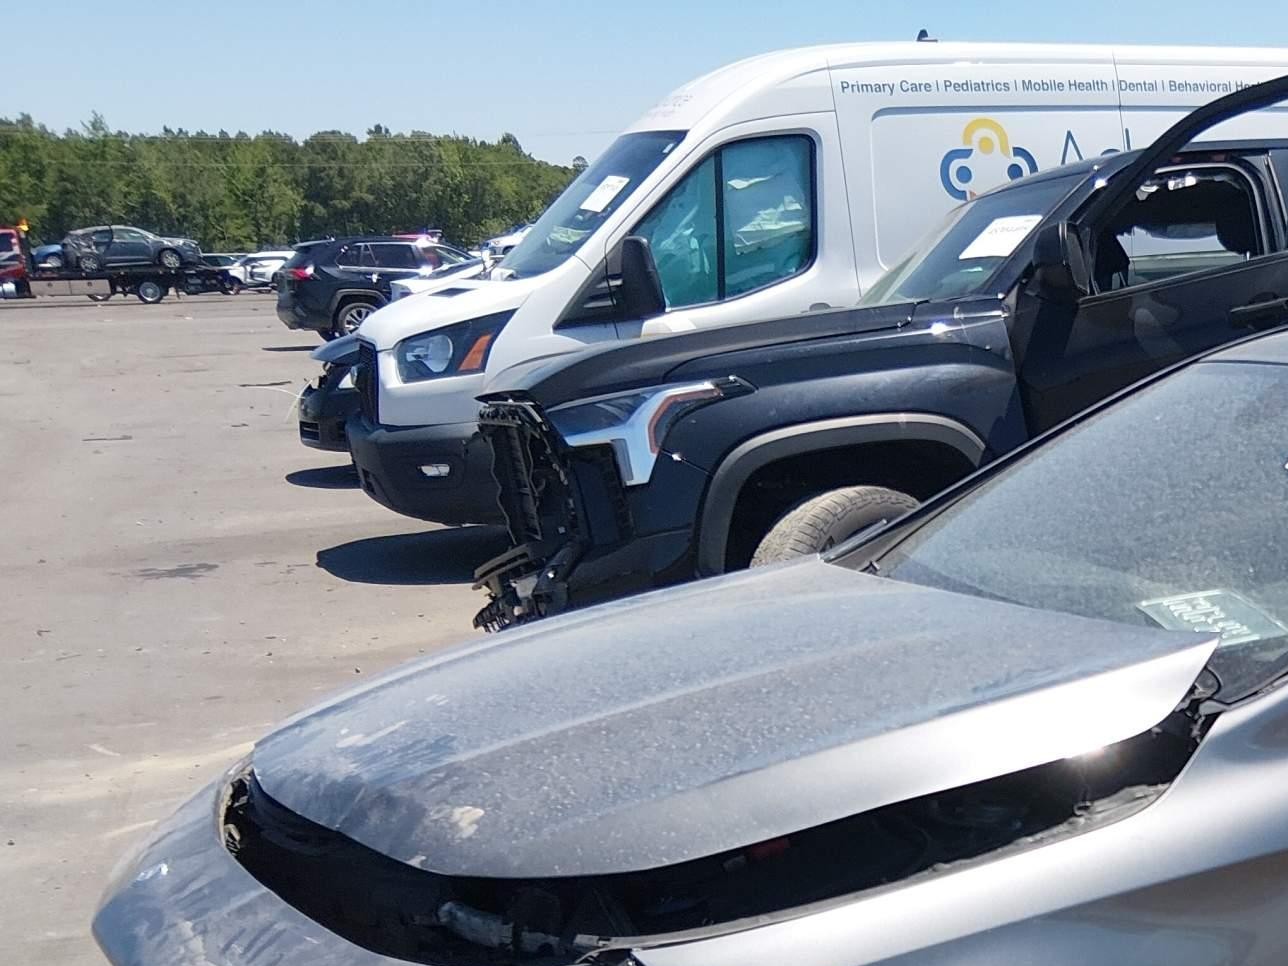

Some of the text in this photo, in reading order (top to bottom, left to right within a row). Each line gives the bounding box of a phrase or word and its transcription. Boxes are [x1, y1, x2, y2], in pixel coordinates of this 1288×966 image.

[840, 80, 895, 96] Primary
[899, 79, 932, 93] Care
[943, 79, 1010, 93] Pediatrics
[1021, 79, 1065, 92] Mobile
[1068, 79, 1108, 92] Health
[1119, 79, 1158, 93] Dental
[1168, 80, 1232, 93] Behavioral
